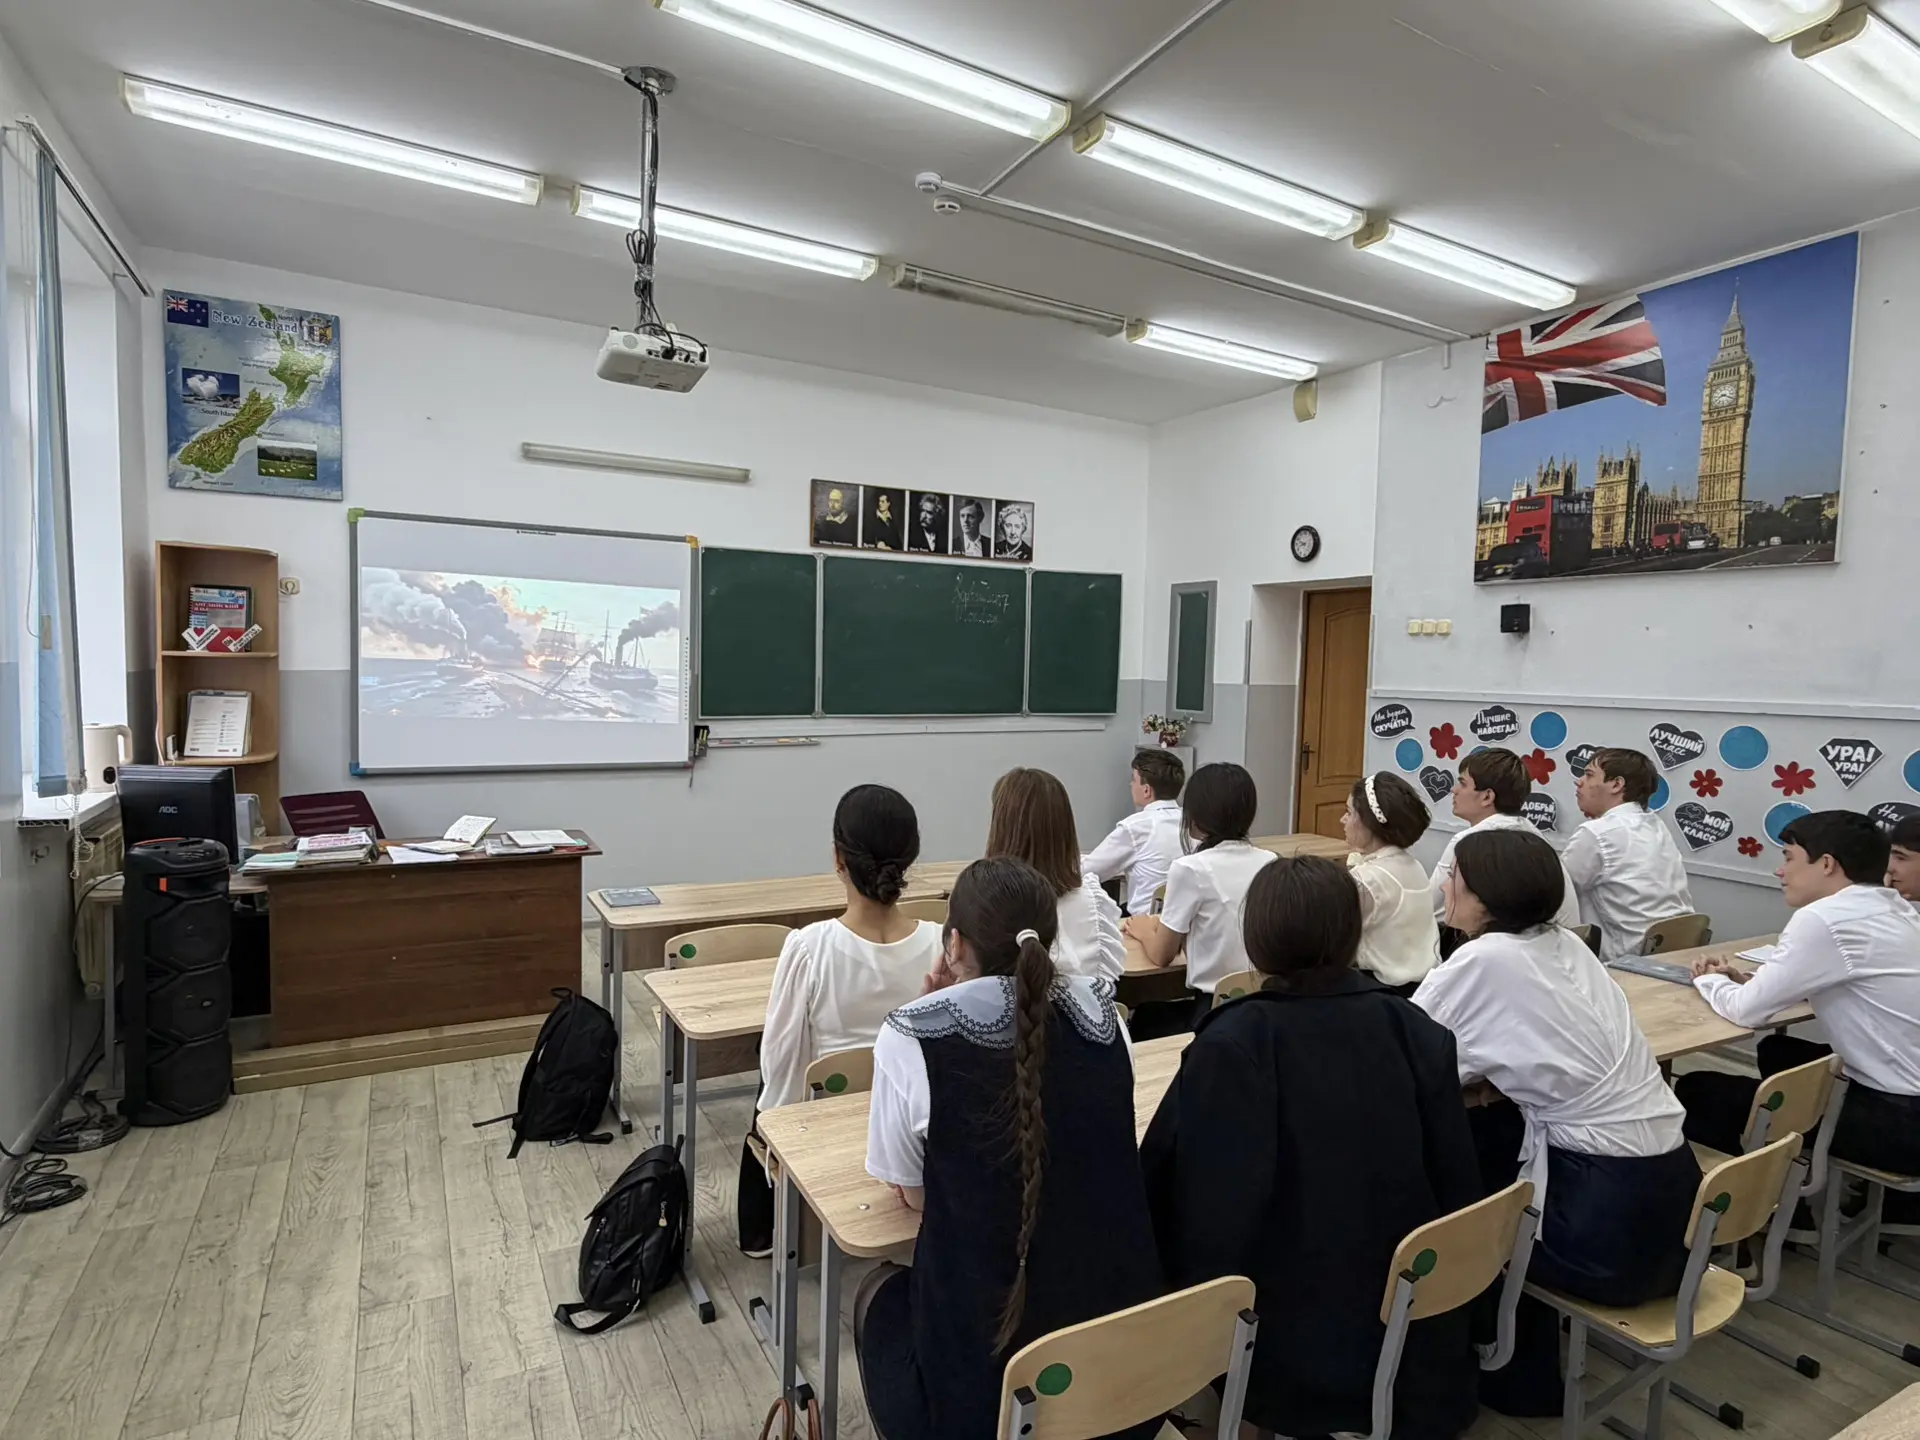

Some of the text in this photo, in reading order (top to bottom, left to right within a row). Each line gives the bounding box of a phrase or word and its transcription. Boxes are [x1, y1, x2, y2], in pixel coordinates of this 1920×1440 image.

[211, 309, 299, 334] New Zealand
[200, 408, 220, 416] South
[1476, 711, 1512, 727] Лучшие
[1477, 722, 1520, 736] НАВСЕГДА!
[1649, 728, 1704, 754] ЛУЧШИЙ
[1825, 745, 1877, 763] УРА!
[1834, 761, 1865, 773] УРА!
[158, 805, 178, 814] AOC
[1702, 814, 1732, 833] МОЙ
[1683, 826, 1717, 843] КЛАСС
